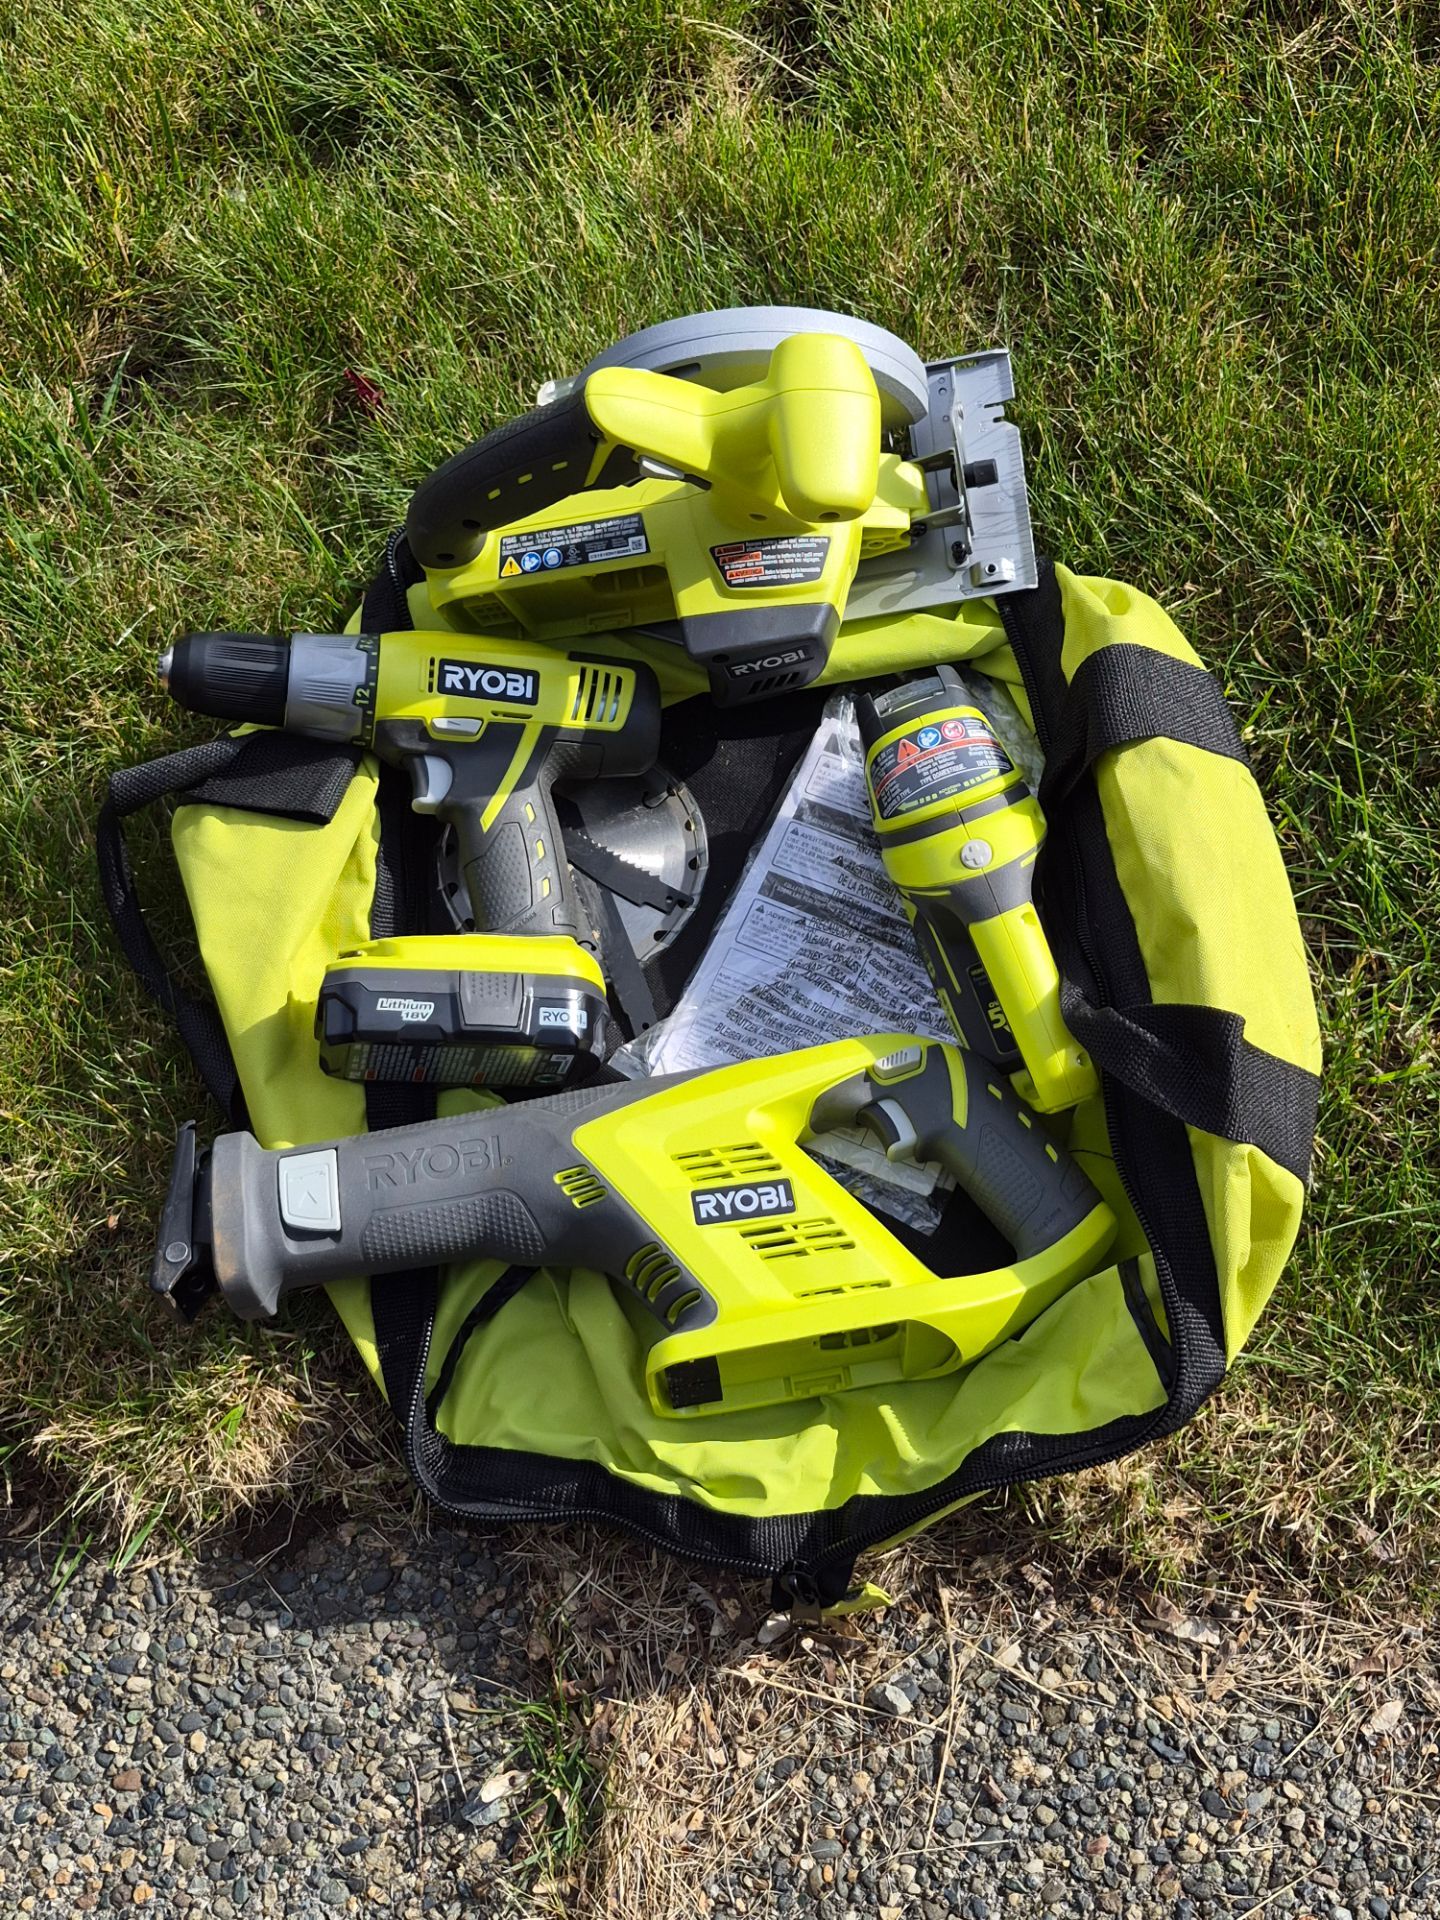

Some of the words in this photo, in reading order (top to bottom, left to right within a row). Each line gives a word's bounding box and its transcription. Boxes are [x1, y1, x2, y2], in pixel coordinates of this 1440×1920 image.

[731, 649, 806, 676] RYOBI
[444, 665, 533, 698] RYOBI
[356, 688, 370, 705] 12
[838, 873, 848, 887] DE
[847, 879, 857, 890] LA
[380, 1000, 432, 1011] Lithium
[403, 1011, 429, 1020] 18V
[543, 1011, 582, 1025] RYOI
[363, 1134, 503, 1191] RYOBI
[696, 1185, 788, 1219] RYOBI
